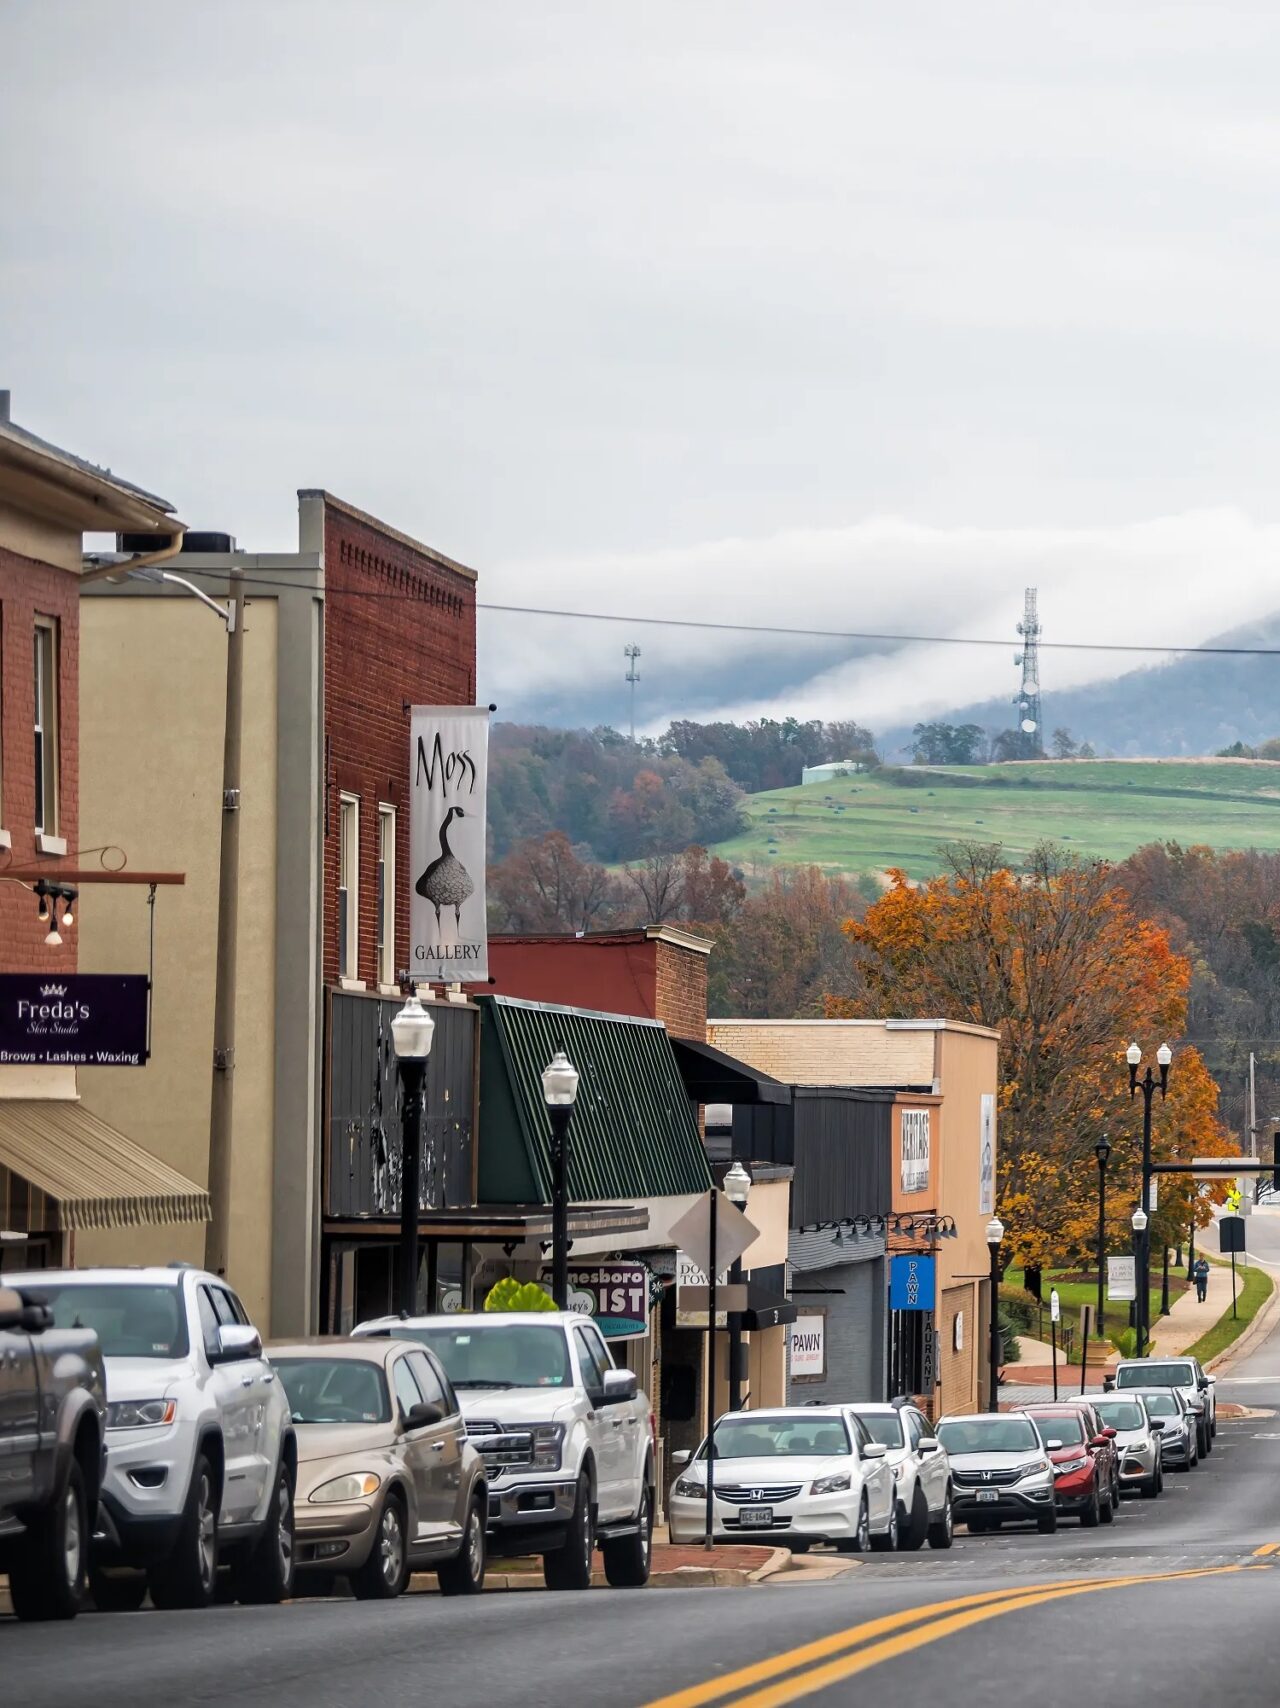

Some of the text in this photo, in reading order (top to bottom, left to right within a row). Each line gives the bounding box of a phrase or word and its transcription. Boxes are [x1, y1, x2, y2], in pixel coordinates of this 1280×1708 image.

[416, 731, 477, 798] Moss
[415, 944, 482, 961] GALLERY
[17, 1000, 90, 1019] Freda's
[26, 1019, 79, 1034] Skin Studio
[0, 1050, 139, 1065] Brows Lashes Waxing
[681, 1264, 701, 1275] DO
[906, 1261, 919, 1305] PAWN
[793, 1333, 820, 1352] PAWN
